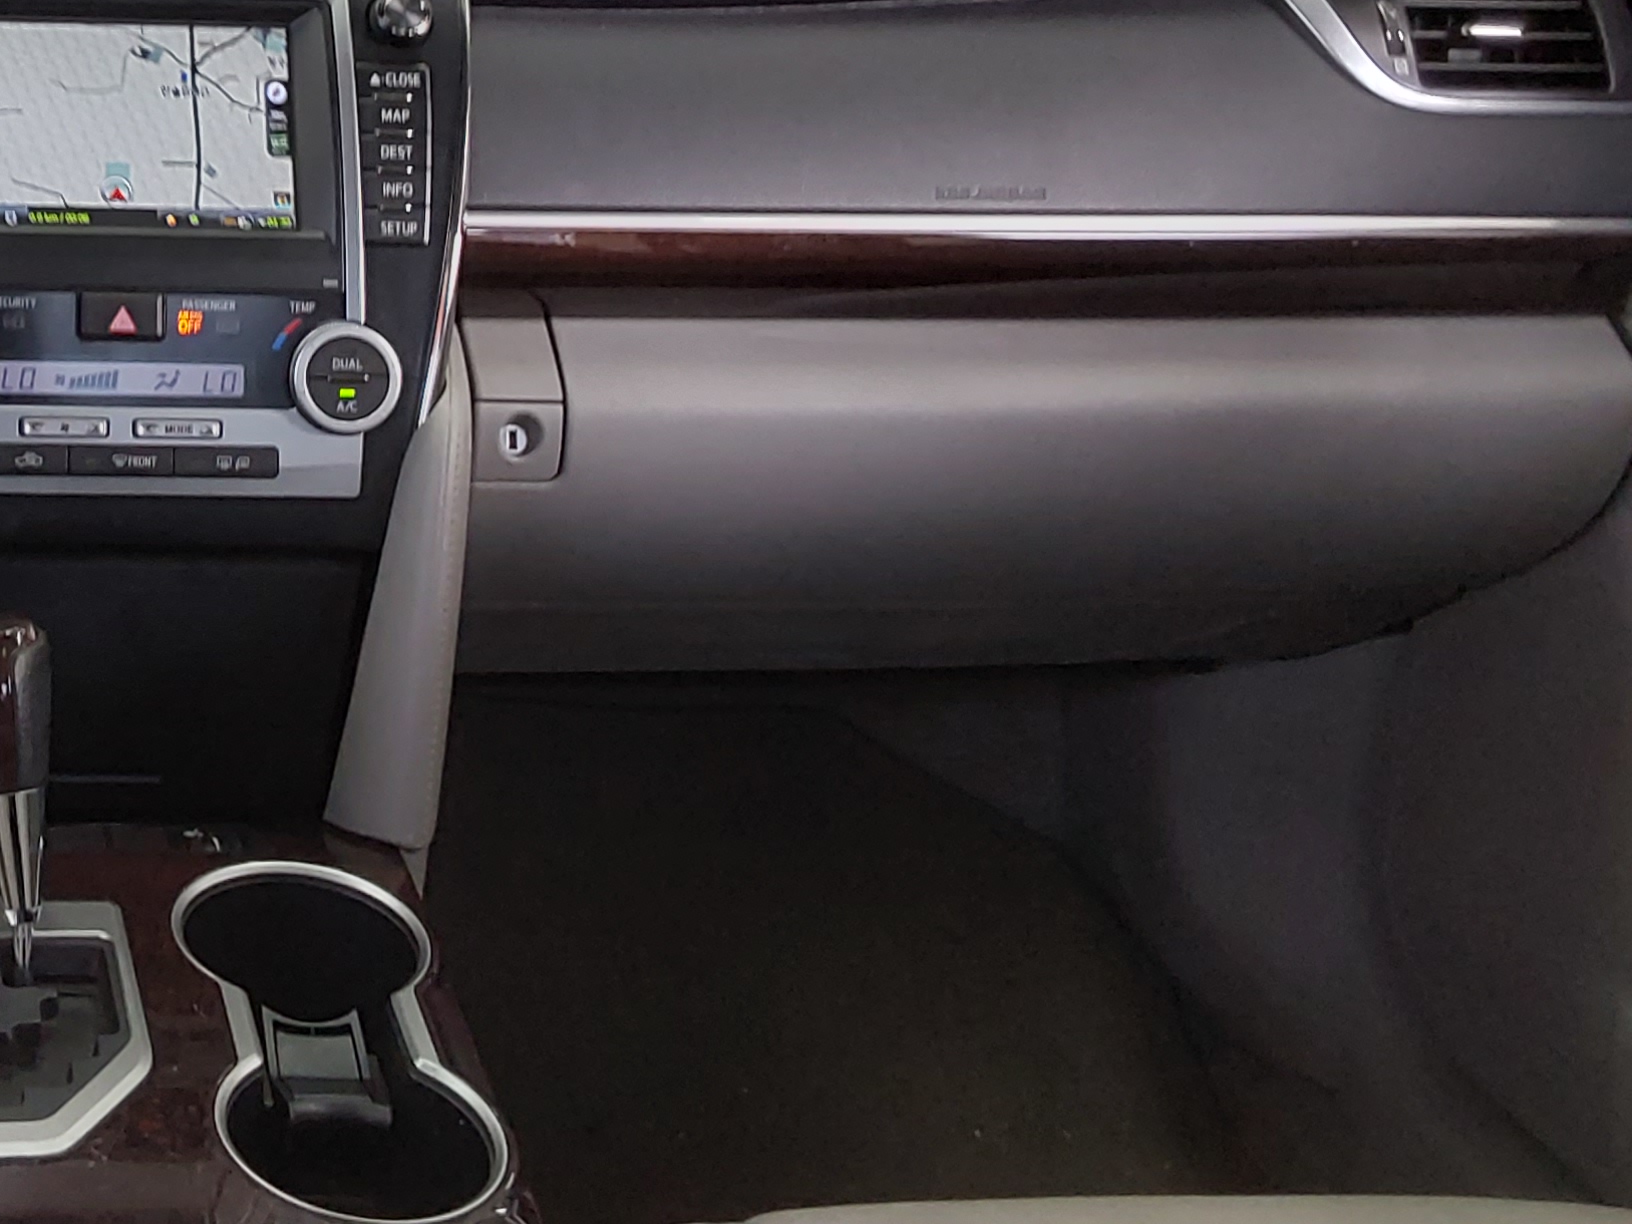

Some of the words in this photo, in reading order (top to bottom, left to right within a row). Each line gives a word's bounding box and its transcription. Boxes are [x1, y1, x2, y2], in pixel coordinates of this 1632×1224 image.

[385, 71, 421, 88] CLOSE
[381, 107, 410, 124] MAP
[380, 144, 413, 161] DEST
[382, 181, 414, 198] INFO
[380, 220, 418, 237] SETUP
[181, 299, 236, 312] PASSENGER
[290, 300, 316, 314] TEMP
[177, 320, 203, 335] OFF
[332, 358, 363, 371] DUAL
[337, 401, 358, 413] A/C
[164, 426, 194, 435] MODE
[128, 454, 157, 468] FRONT
